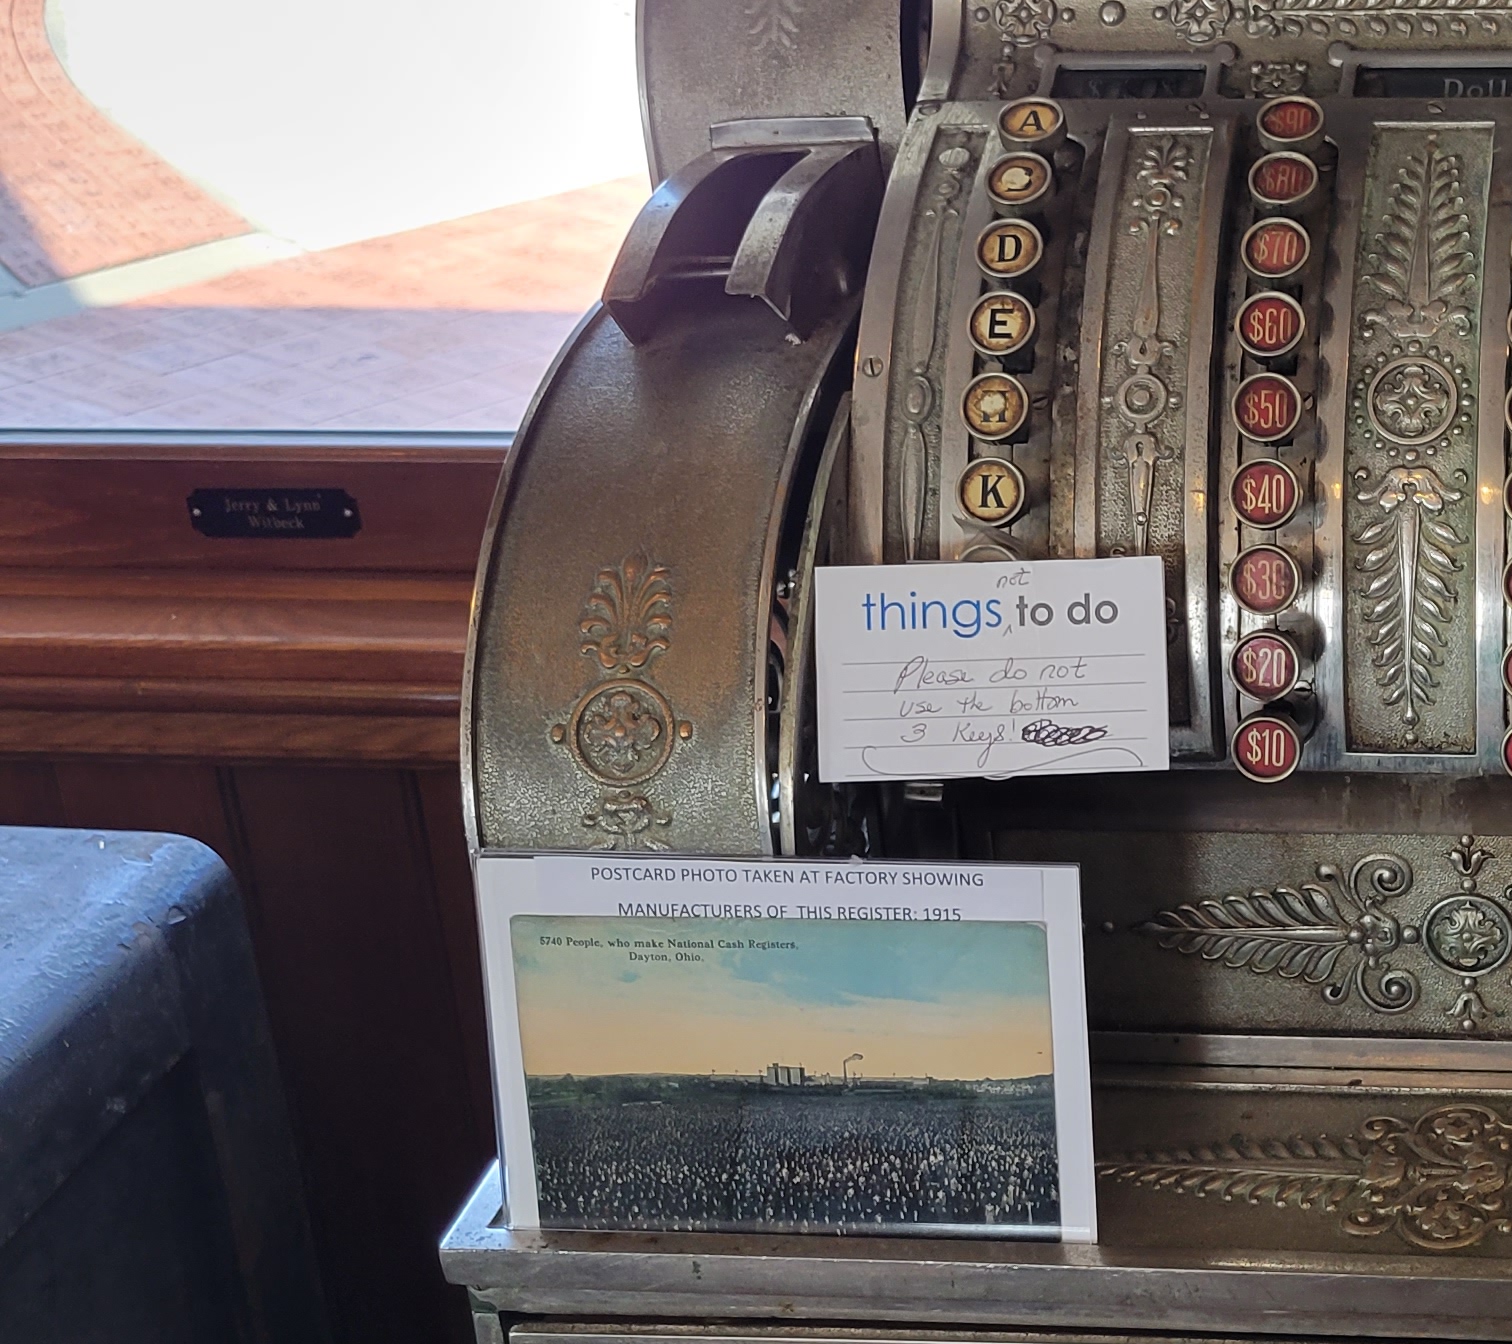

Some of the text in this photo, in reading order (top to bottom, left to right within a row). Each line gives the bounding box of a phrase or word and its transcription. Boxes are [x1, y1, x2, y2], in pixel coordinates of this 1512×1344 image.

[1018, 109, 1047, 133] A
[996, 234, 1022, 263] D
[1253, 231, 1297, 266] $70
[988, 308, 1014, 340] E
[1249, 307, 1292, 345] $60
[1244, 389, 1288, 429] $50
[977, 474, 1008, 509] K
[1242, 474, 1285, 514] $40
[996, 567, 1033, 589] not
[861, 591, 1119, 638] things to do
[894, 655, 1087, 695] Please do not
[1242, 646, 1286, 688] $20
[899, 688, 1079, 718] use the bottom
[900, 722, 927, 743] 3
[1246, 727, 1285, 768] $10
[590, 867, 984, 887] POSTCARD PHOTO TAKEN AT FACTORY SHOWING
[617, 902, 962, 921] MANUFACTURERS OF THIS REGISTER: 1915
[540, 936, 563, 946] 5740
[608, 938, 630, 948] who
[634, 938, 665, 948] make
[667, 938, 714, 949] National
[718, 939, 745, 949] Cash
